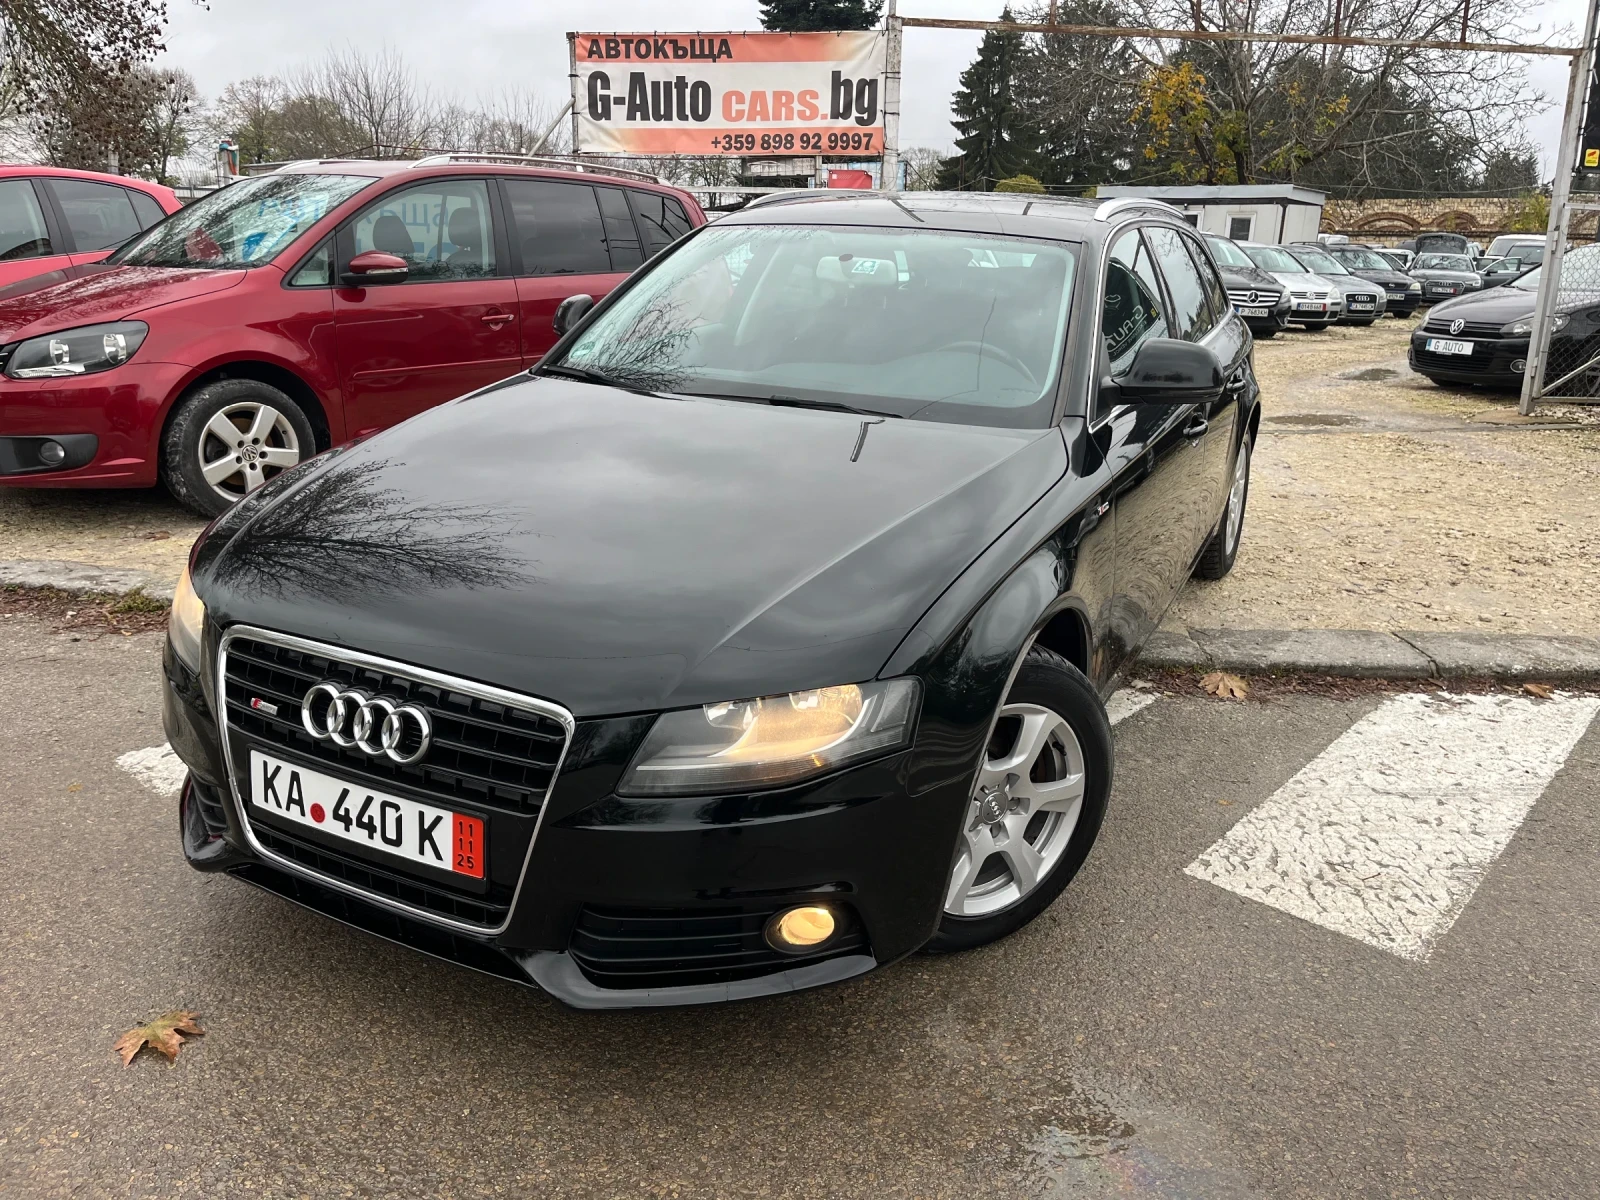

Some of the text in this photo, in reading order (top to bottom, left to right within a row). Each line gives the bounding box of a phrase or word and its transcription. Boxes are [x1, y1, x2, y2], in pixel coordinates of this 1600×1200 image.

[587, 38, 733, 62] АВТОКЪЩА
[587, 70, 712, 122] G-Auto
[711, 132, 874, 151] +359 898 92 9997
[1434, 341, 1464, 352] G AUTO
[262, 760, 444, 861] KA 440 K
[458, 820, 474, 836] 11
[458, 837, 474, 852] 11
[457, 854, 474, 869] 25
